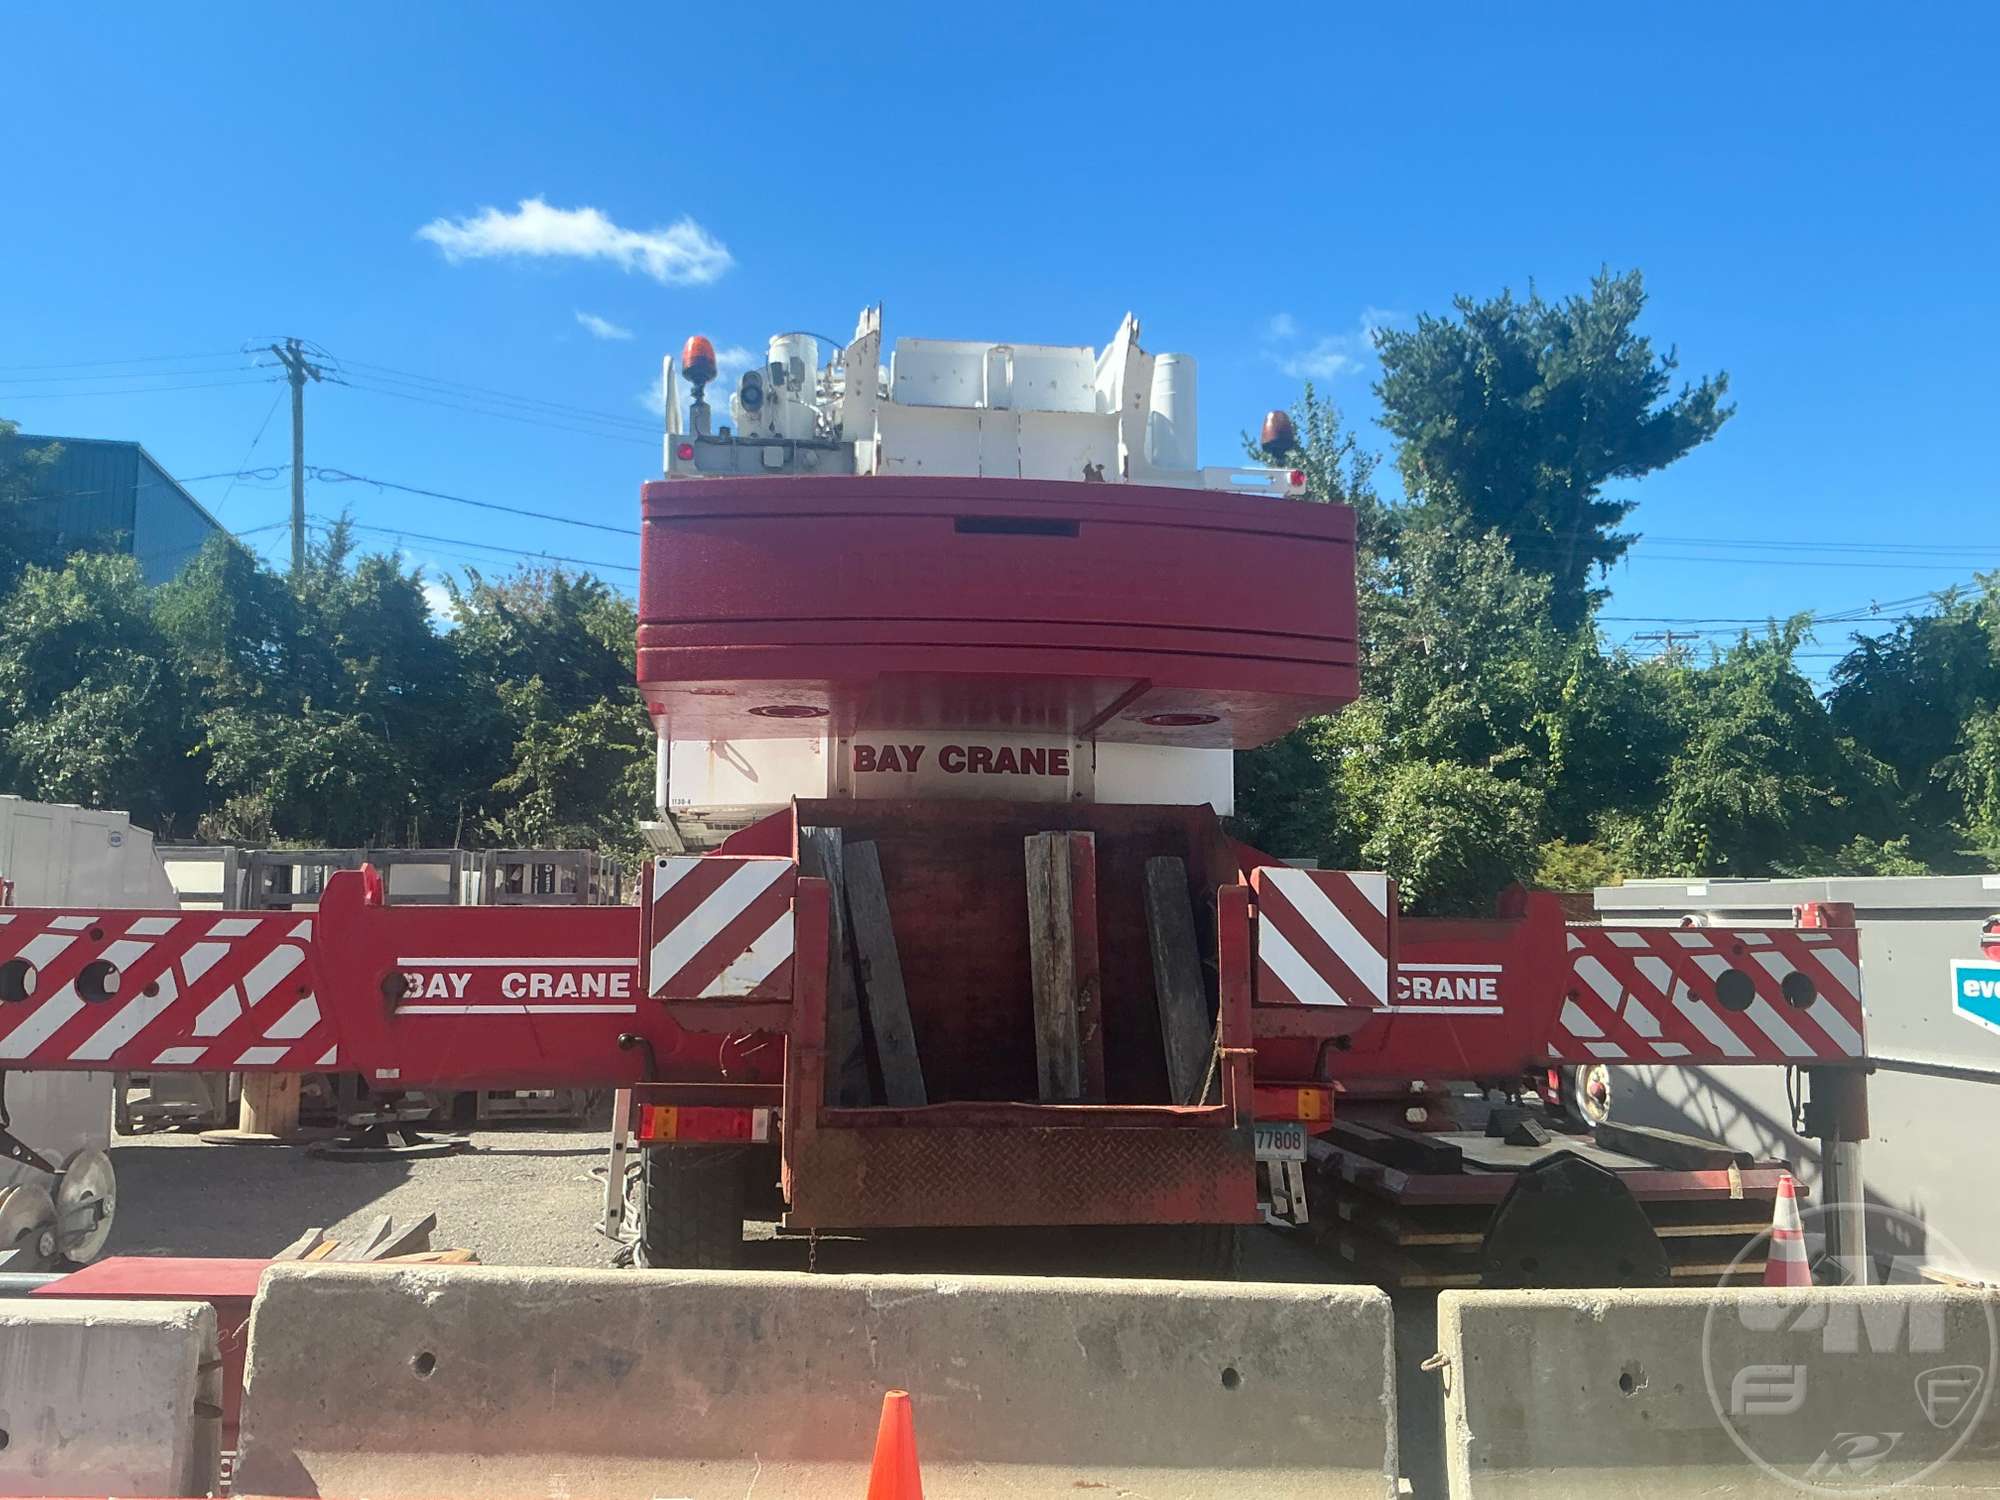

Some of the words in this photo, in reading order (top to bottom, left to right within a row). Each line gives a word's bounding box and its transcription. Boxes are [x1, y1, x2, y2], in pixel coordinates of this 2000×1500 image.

[853, 745, 925, 773] BAY
[938, 745, 1070, 776] CRANE
[402, 972, 473, 999] BAY
[501, 972, 631, 999] CRANE
[1397, 976, 1498, 1000] CRANE
[1255, 1130, 1301, 1150] 77808
